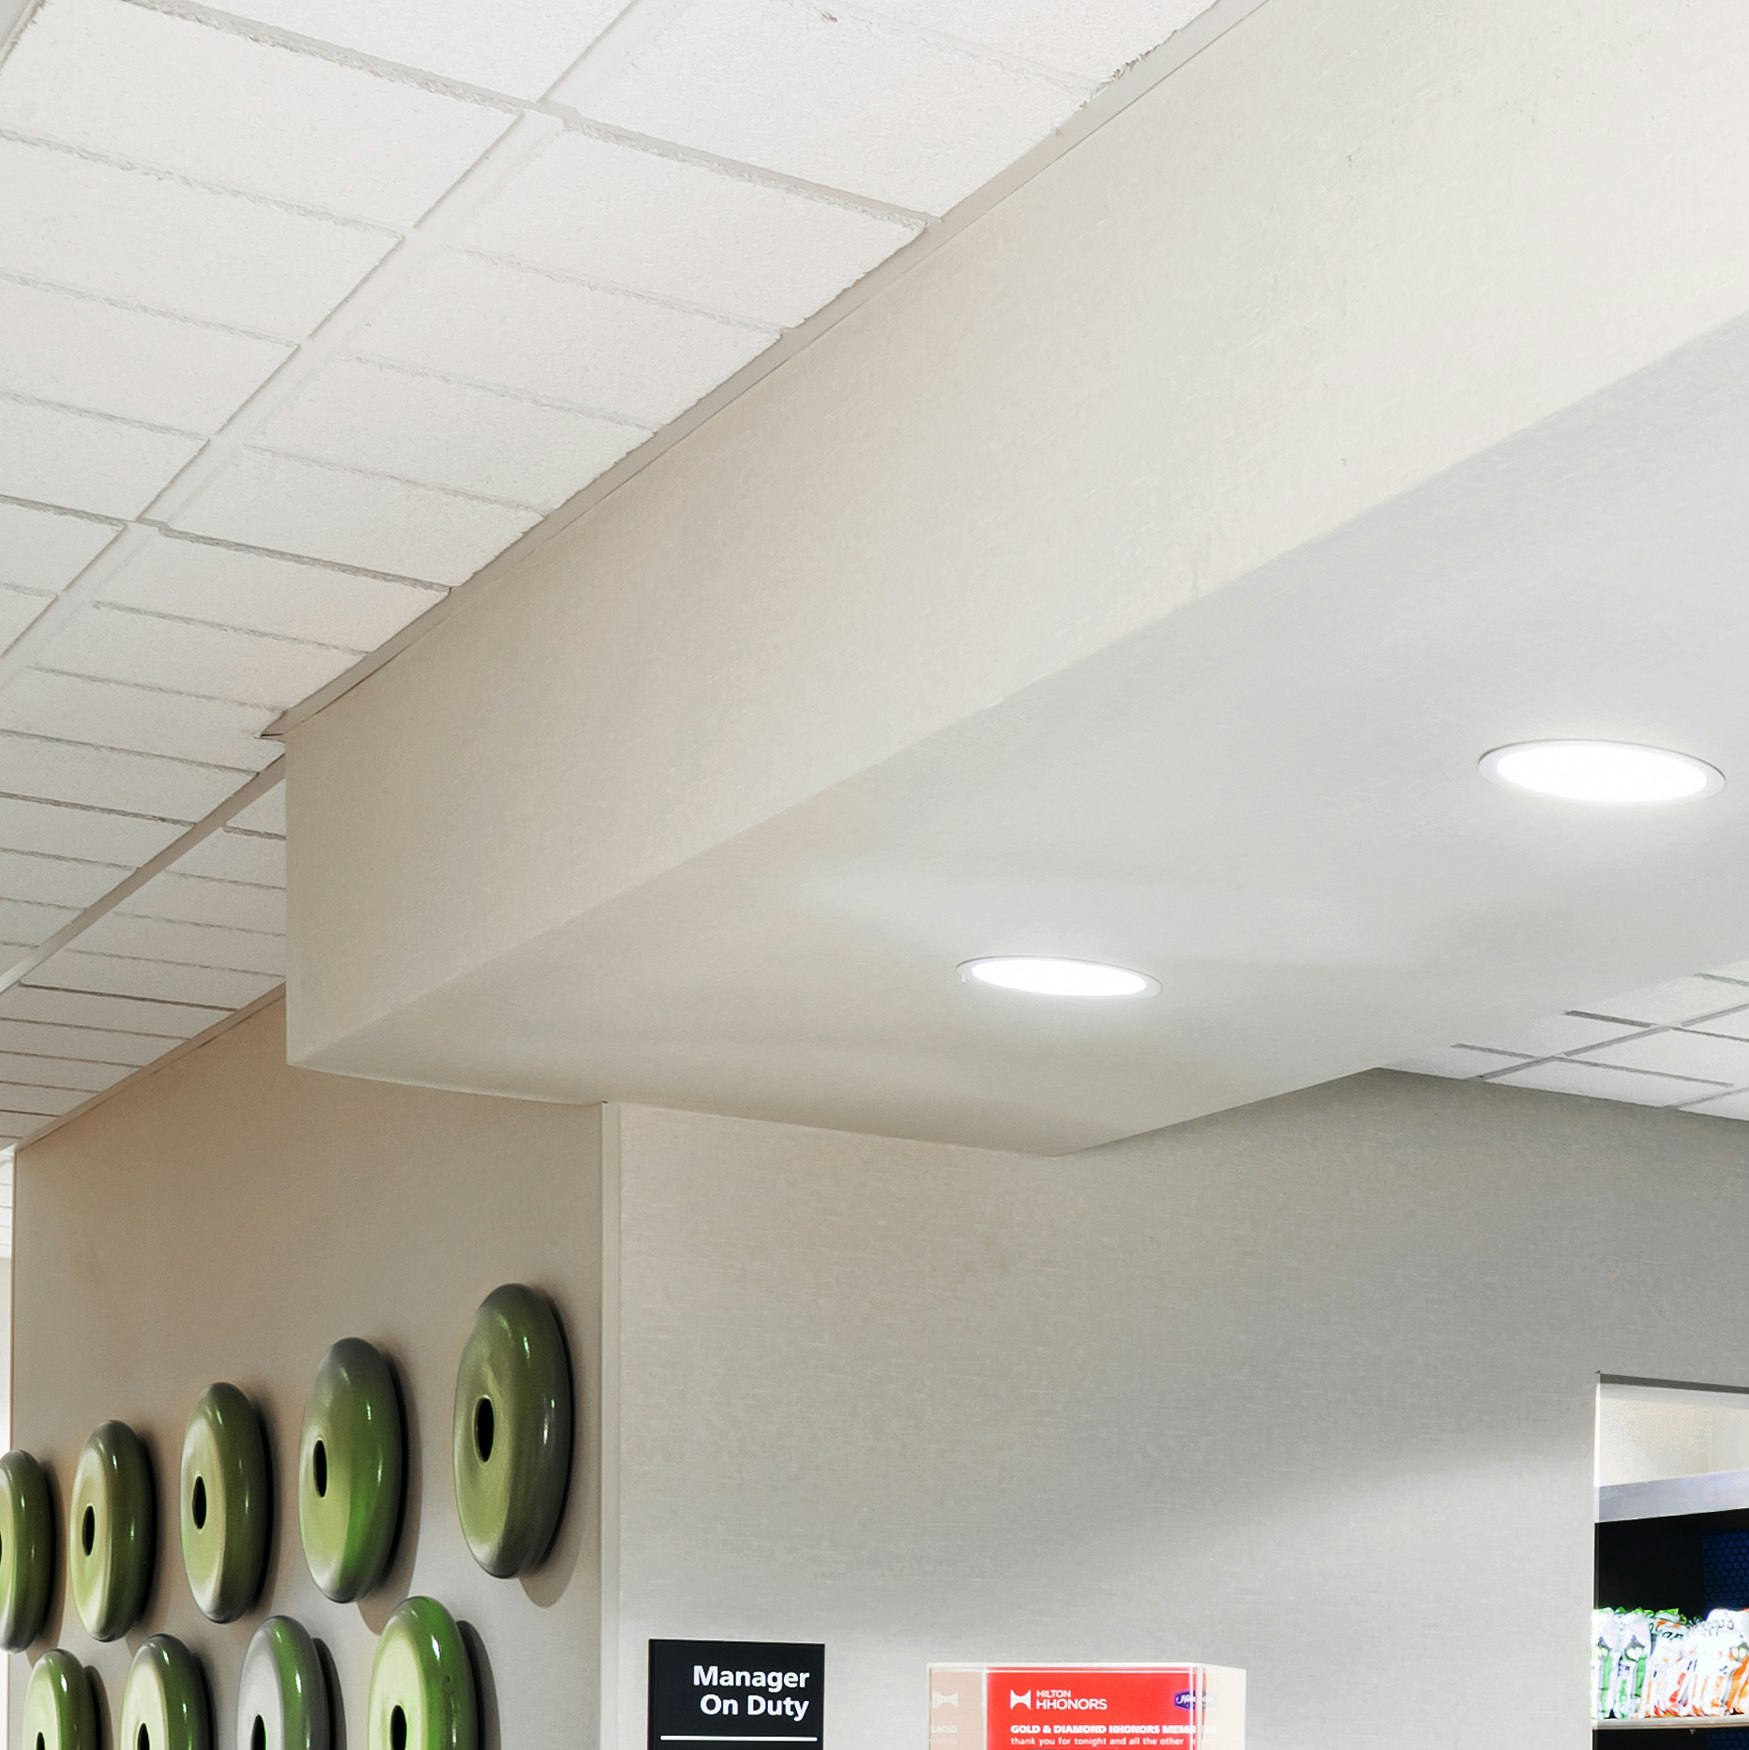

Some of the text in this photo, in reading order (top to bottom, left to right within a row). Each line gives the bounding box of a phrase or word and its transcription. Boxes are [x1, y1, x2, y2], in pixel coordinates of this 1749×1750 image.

[693, 1665, 810, 1693] Manager
[1036, 1689, 1072, 1698] HILTON
[700, 1694, 810, 1722] On Duty
[1036, 1698, 1108, 1711] HHONORS
[1010, 1724, 1041, 1734] GOLD
[1042, 1724, 1052, 1734] &
[1053, 1724, 1107, 1734] DIAMOND
[1108, 1724, 1161, 1734] HHONORS
[1010, 1737, 1036, 1746] thank
[1039, 1738, 1056, 1747] you
[1058, 1737, 1071, 1746] for
[1074, 1737, 1107, 1748] tonight
[1109, 1737, 1127, 1746] and
[1129, 1737, 1141, 1746] all
[1143, 1737, 1158, 1746] the
[1160, 1737, 1185, 1746] other
